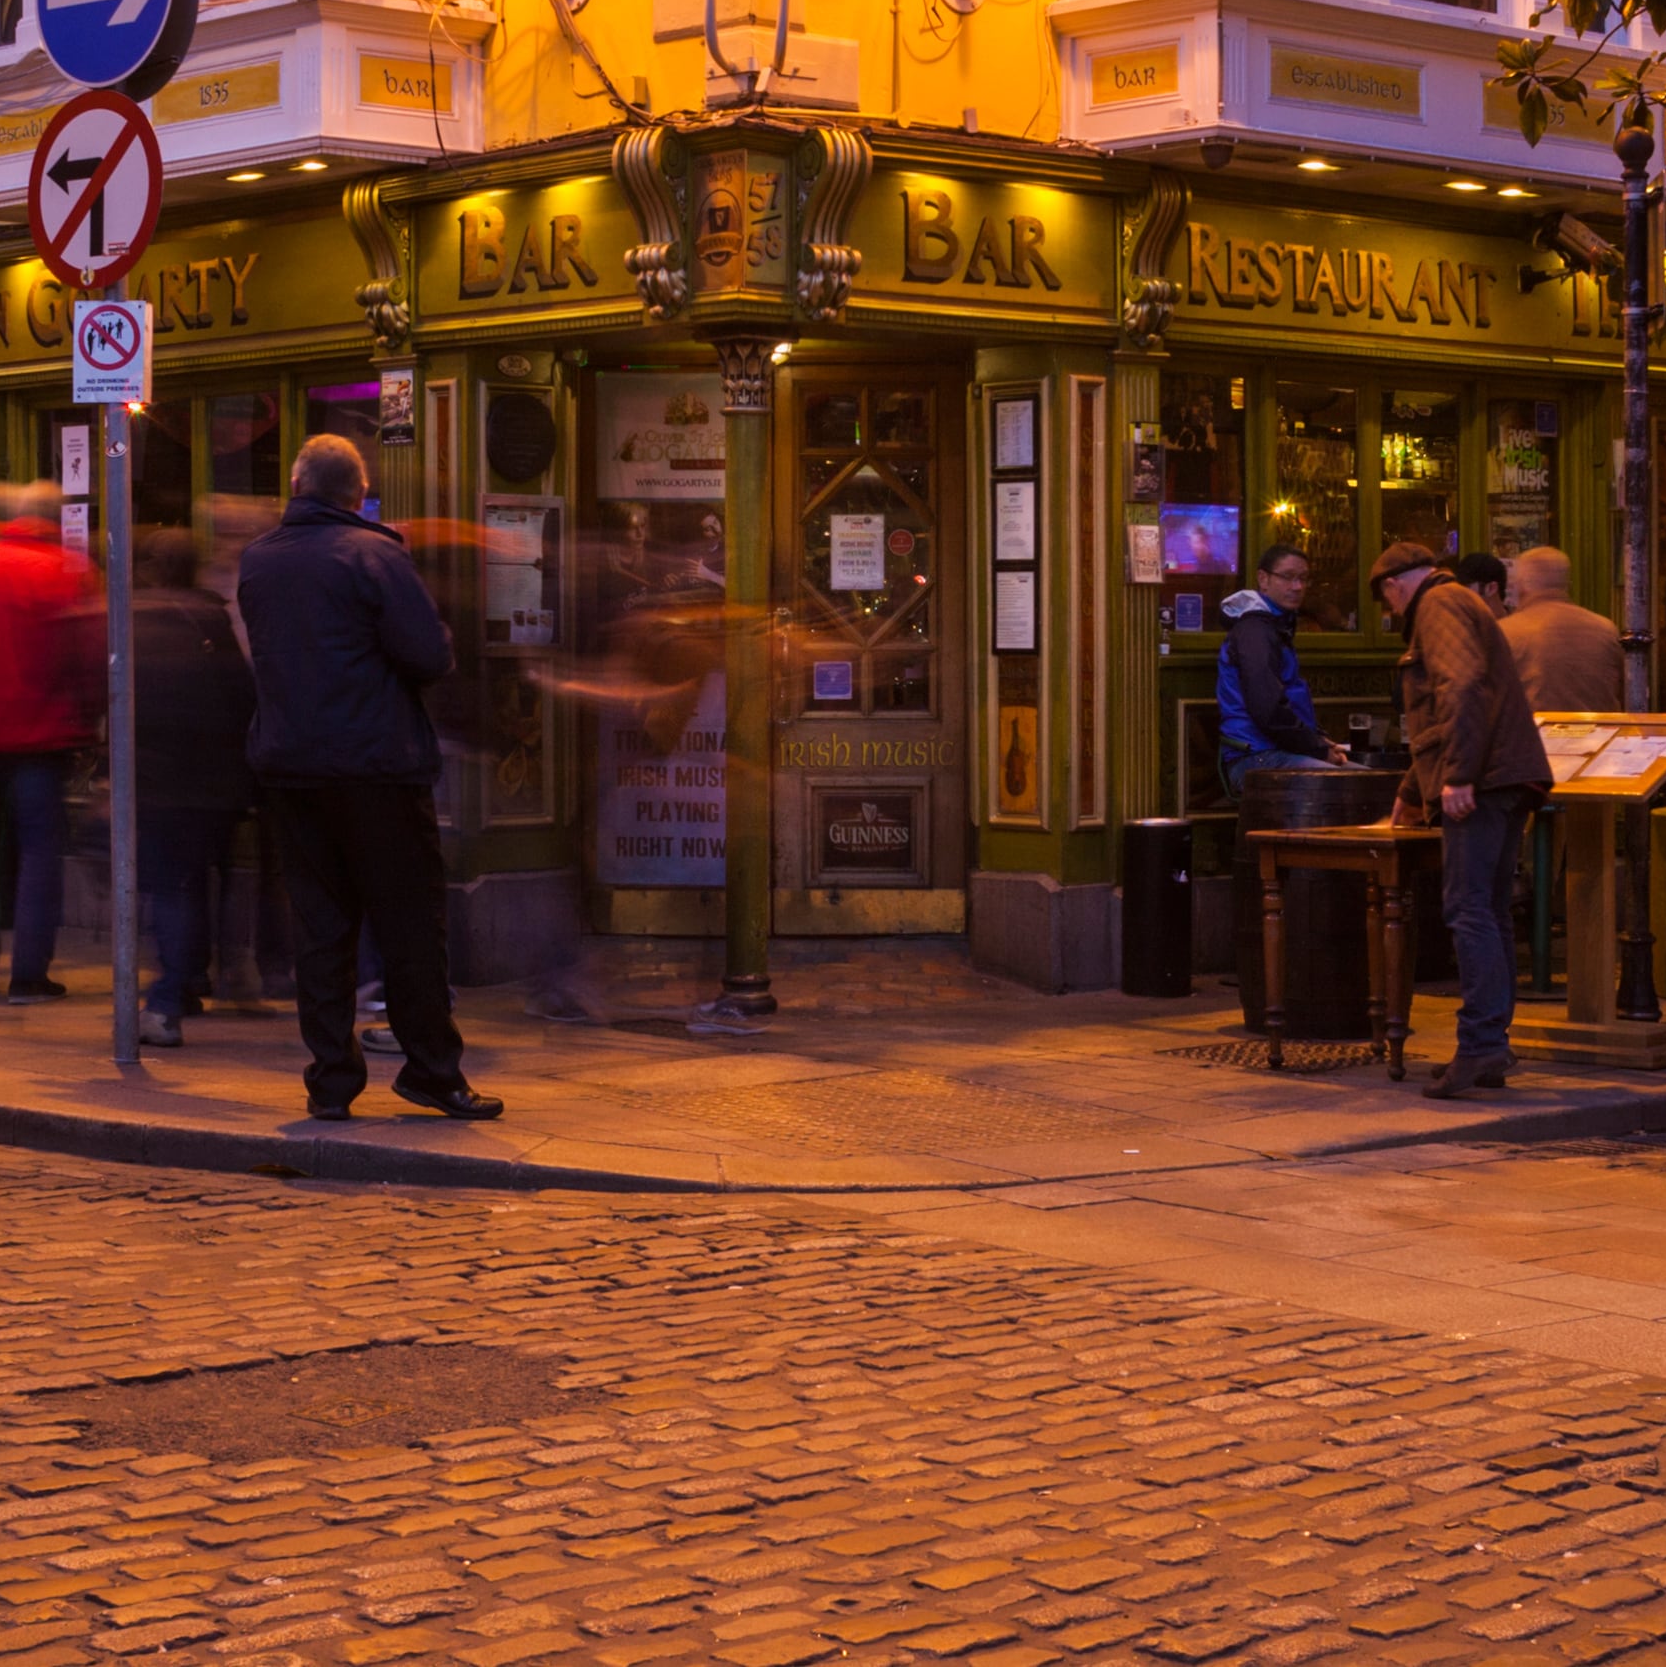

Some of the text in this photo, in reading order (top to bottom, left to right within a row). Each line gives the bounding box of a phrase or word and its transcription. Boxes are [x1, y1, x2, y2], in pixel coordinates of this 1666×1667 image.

[199, 80, 230, 107] 1835
[458, 205, 599, 300] BAR
[902, 188, 1062, 292] BAR
[1185, 219, 1497, 329] RESTAURANT
[26, 252, 261, 349] GOARTY
[617, 765, 727, 789] IRISH MUSI
[636, 801, 720, 823] PLAYING
[616, 836, 727, 859] RIGHT NOW
[829, 823, 910, 845] GUINNESS
